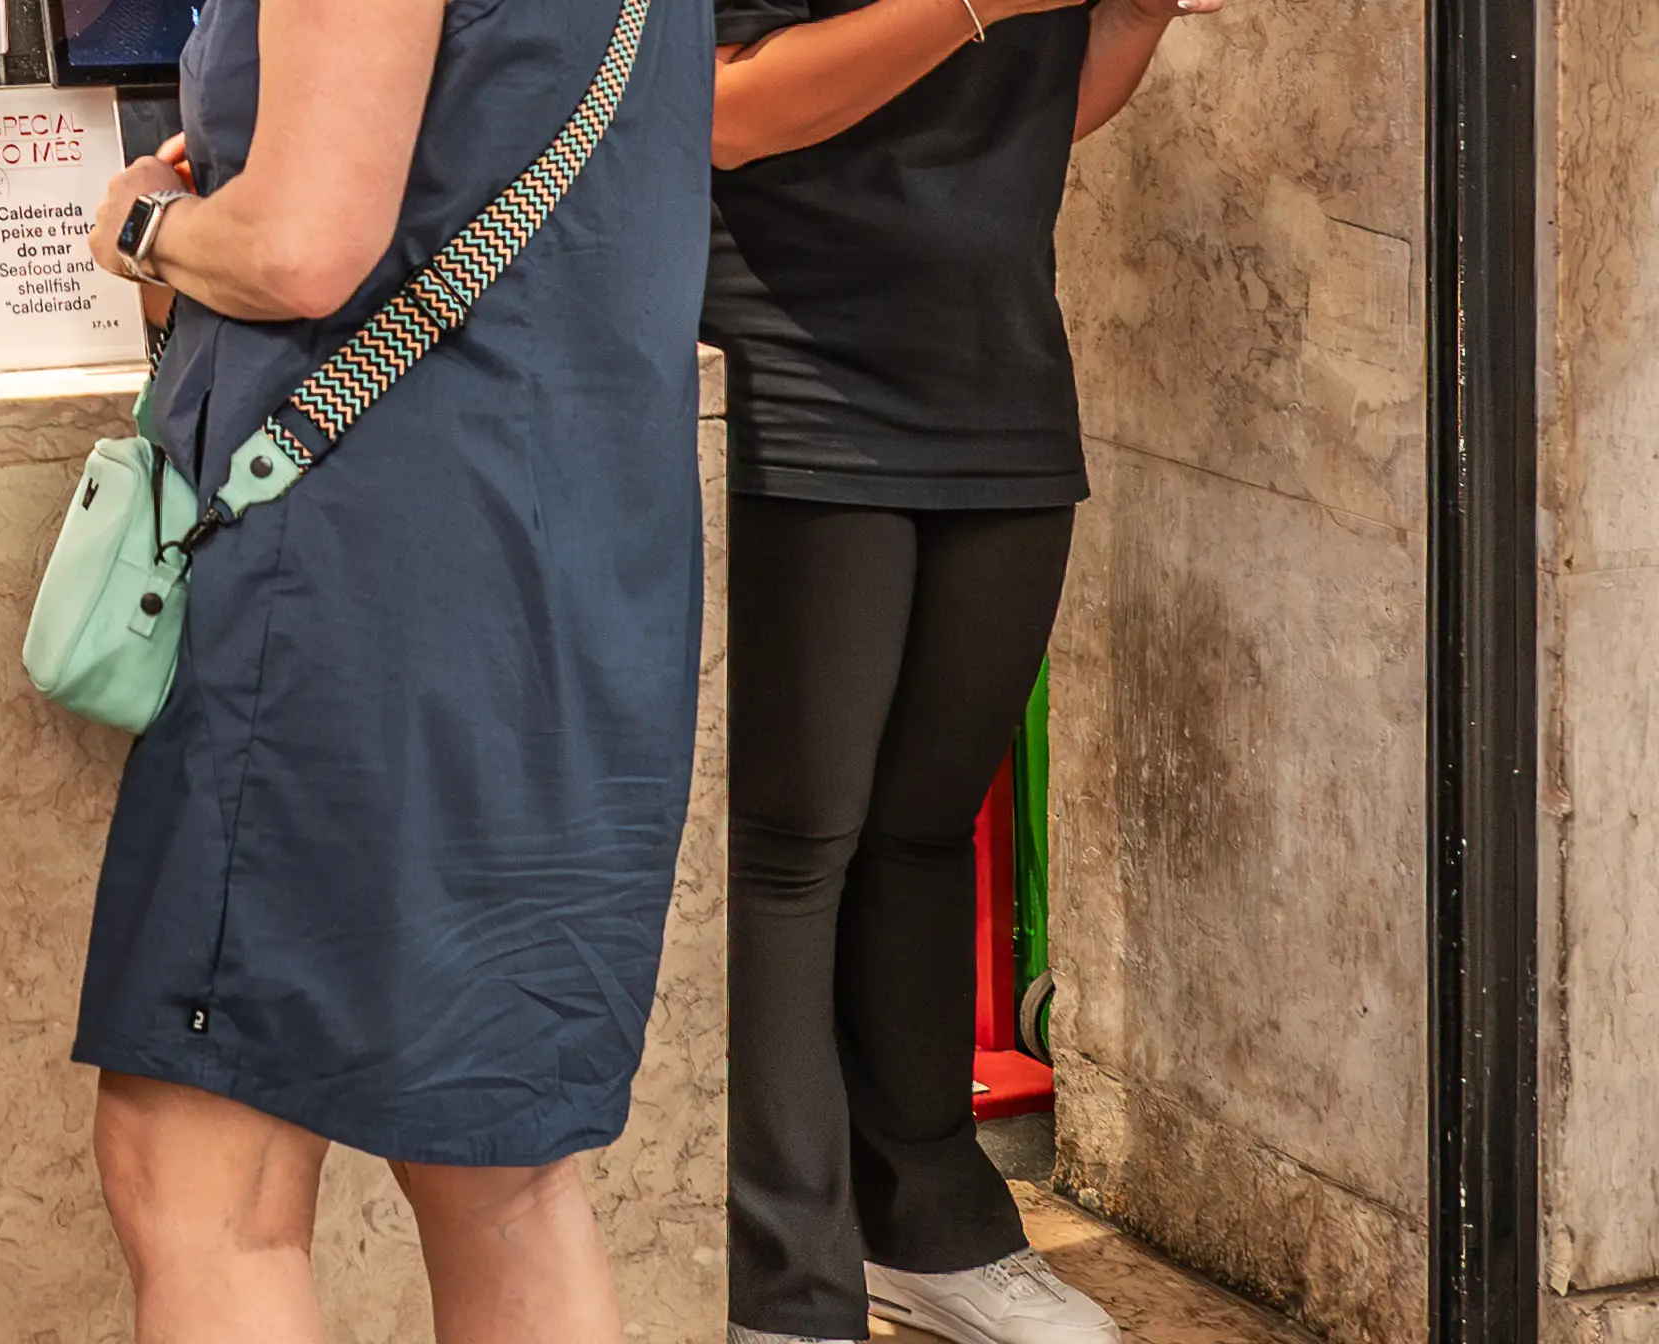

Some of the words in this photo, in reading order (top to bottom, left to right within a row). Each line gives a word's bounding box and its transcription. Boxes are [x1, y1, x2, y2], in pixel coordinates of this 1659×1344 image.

[18, 243, 37, 257] do
[42, 245, 71, 255] mar
[0, 260, 61, 277] Seafood
[67, 258, 94, 273] and
[19, 277, 80, 295] shellfish
